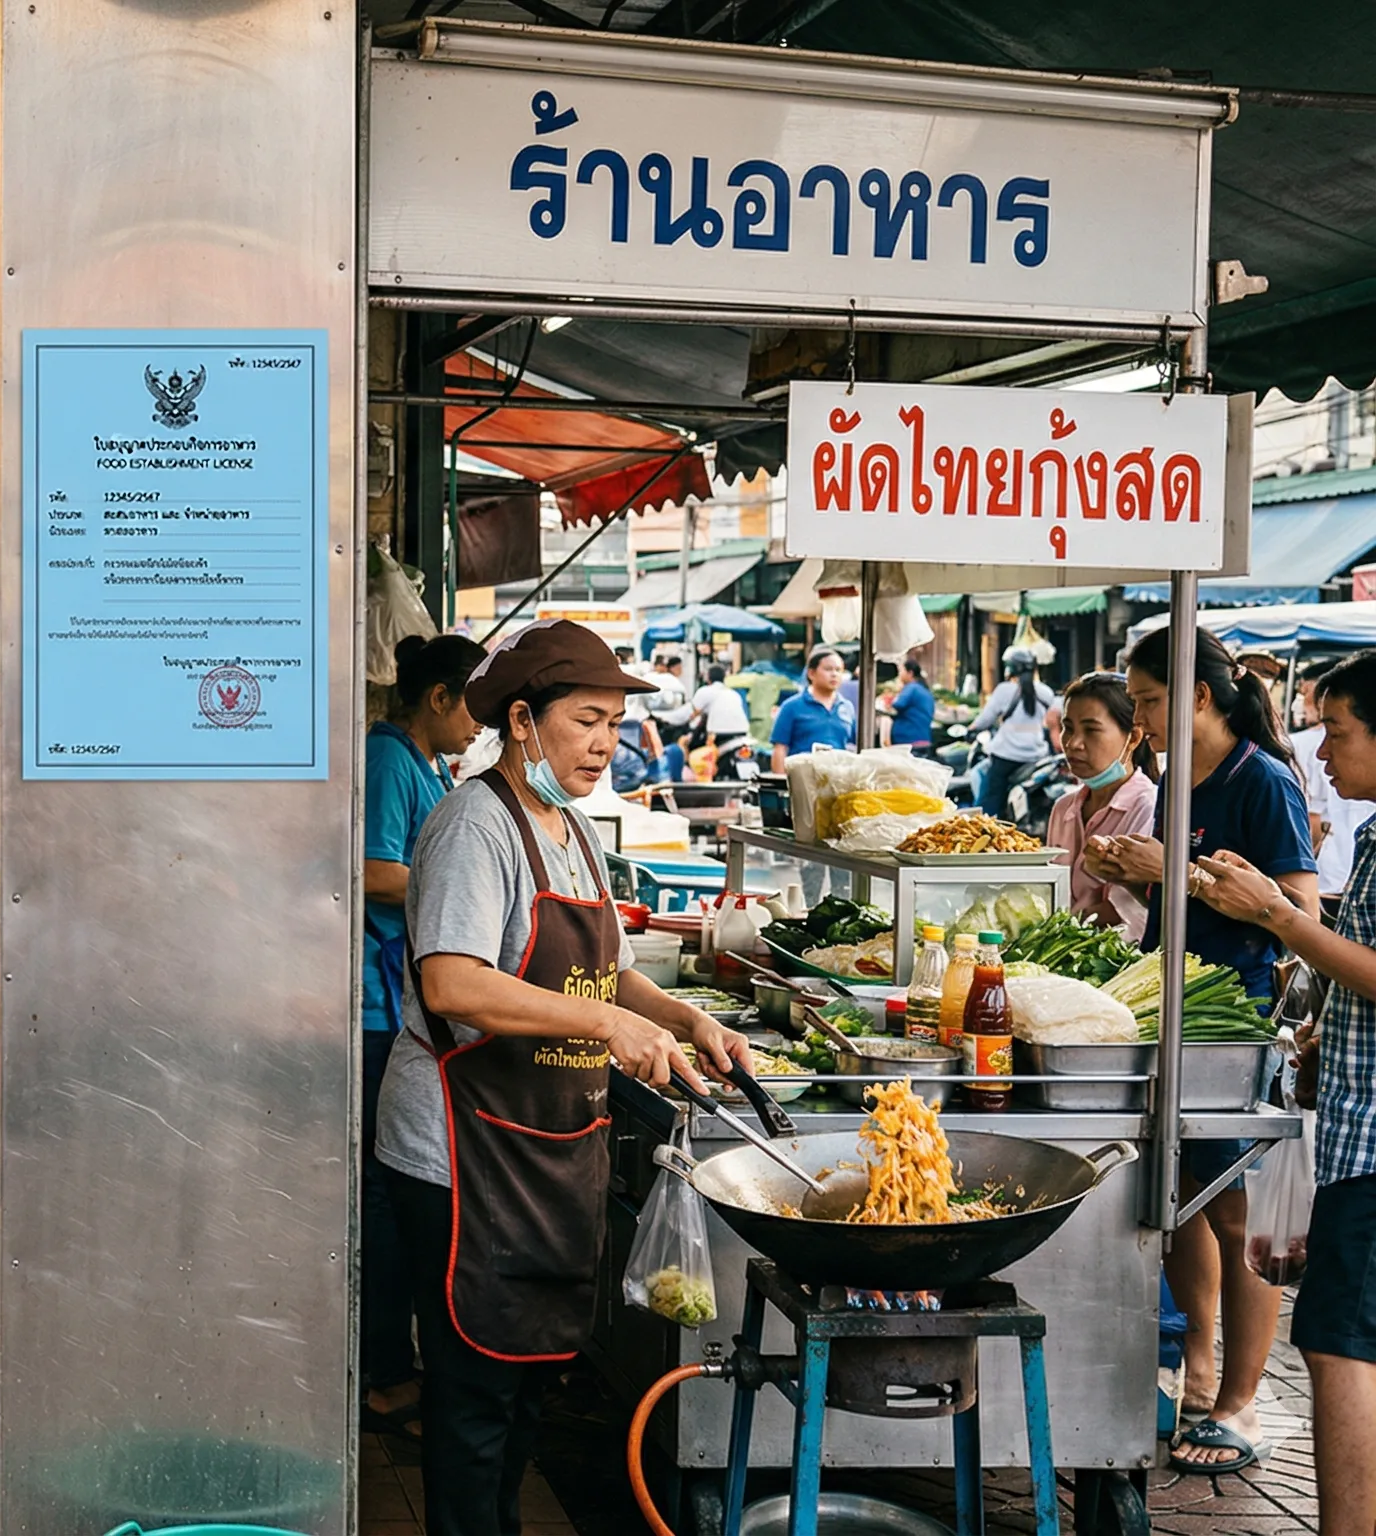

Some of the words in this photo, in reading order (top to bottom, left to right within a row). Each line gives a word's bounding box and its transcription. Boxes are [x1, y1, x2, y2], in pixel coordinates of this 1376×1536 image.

[510, 89, 1051, 268] ร้านอาหาร
[97, 458, 127, 470] FOOD
[129, 458, 211, 470] ESTABLISHMENT
[213, 458, 253, 470] LICENSE
[812, 404, 1202, 560] ผัดไทยกุ้งสด
